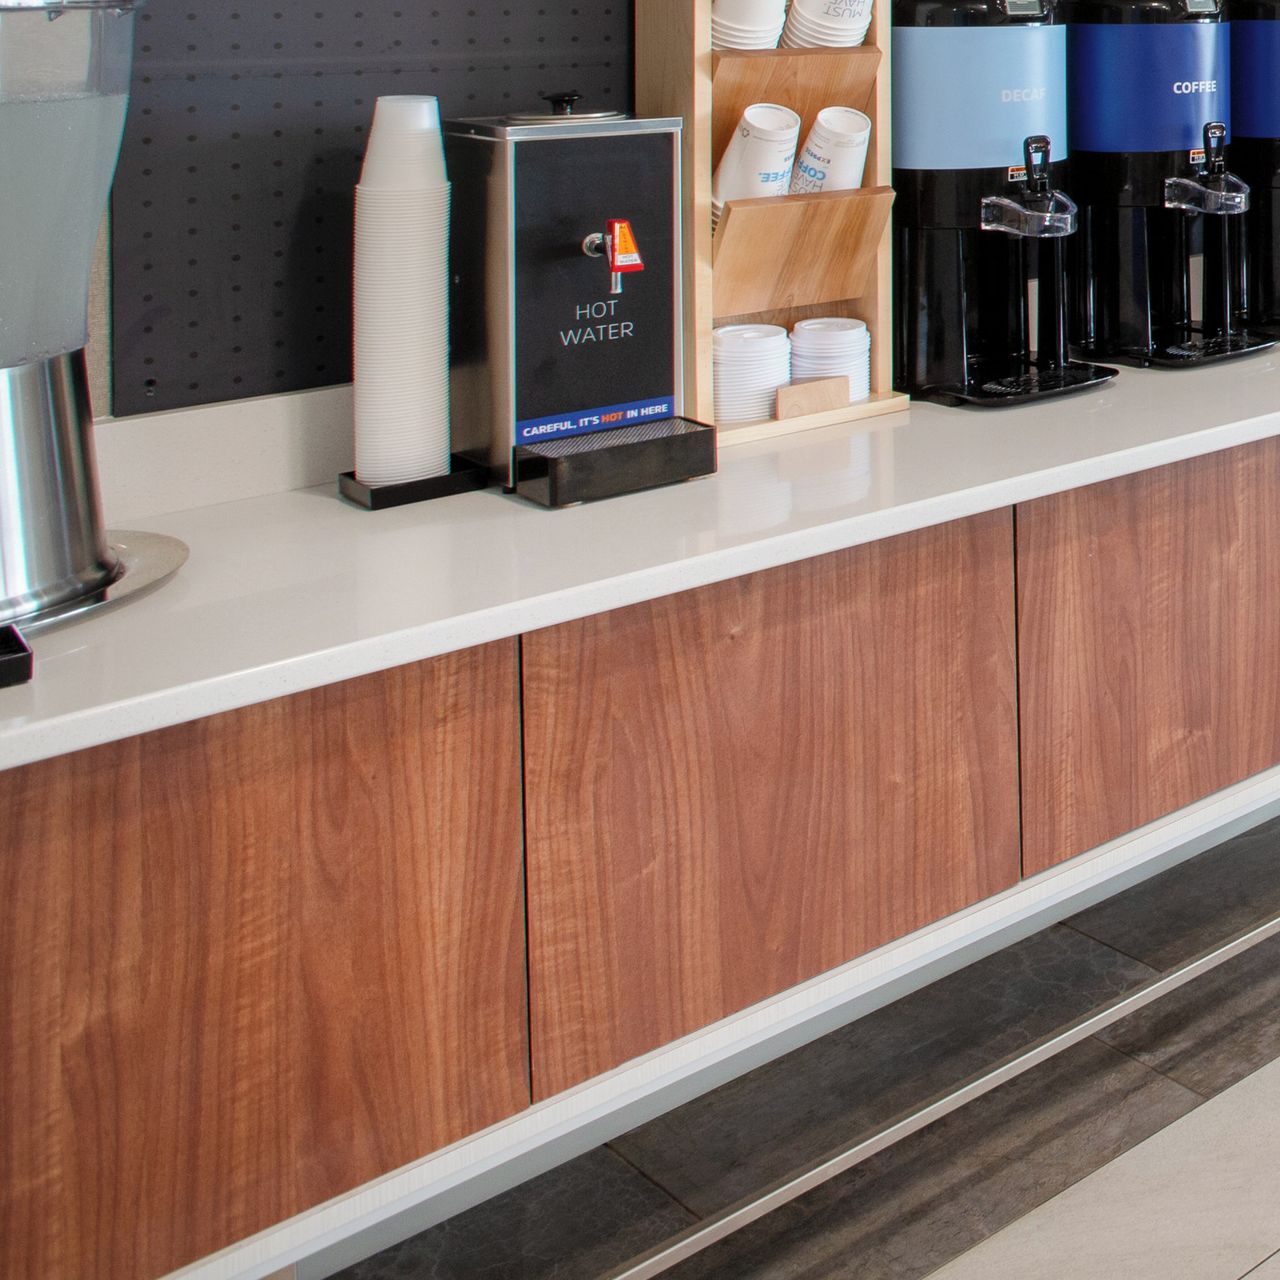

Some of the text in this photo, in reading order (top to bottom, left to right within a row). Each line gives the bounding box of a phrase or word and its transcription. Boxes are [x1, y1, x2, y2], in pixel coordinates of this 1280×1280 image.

[1001, 87, 1047, 103] DECAF
[1173, 80, 1217, 94] COFFEE
[576, 300, 618, 321] HOT
[560, 321, 634, 347] WATER
[522, 404, 668, 437] CAREFUL, IT'S HOT IN HERE
